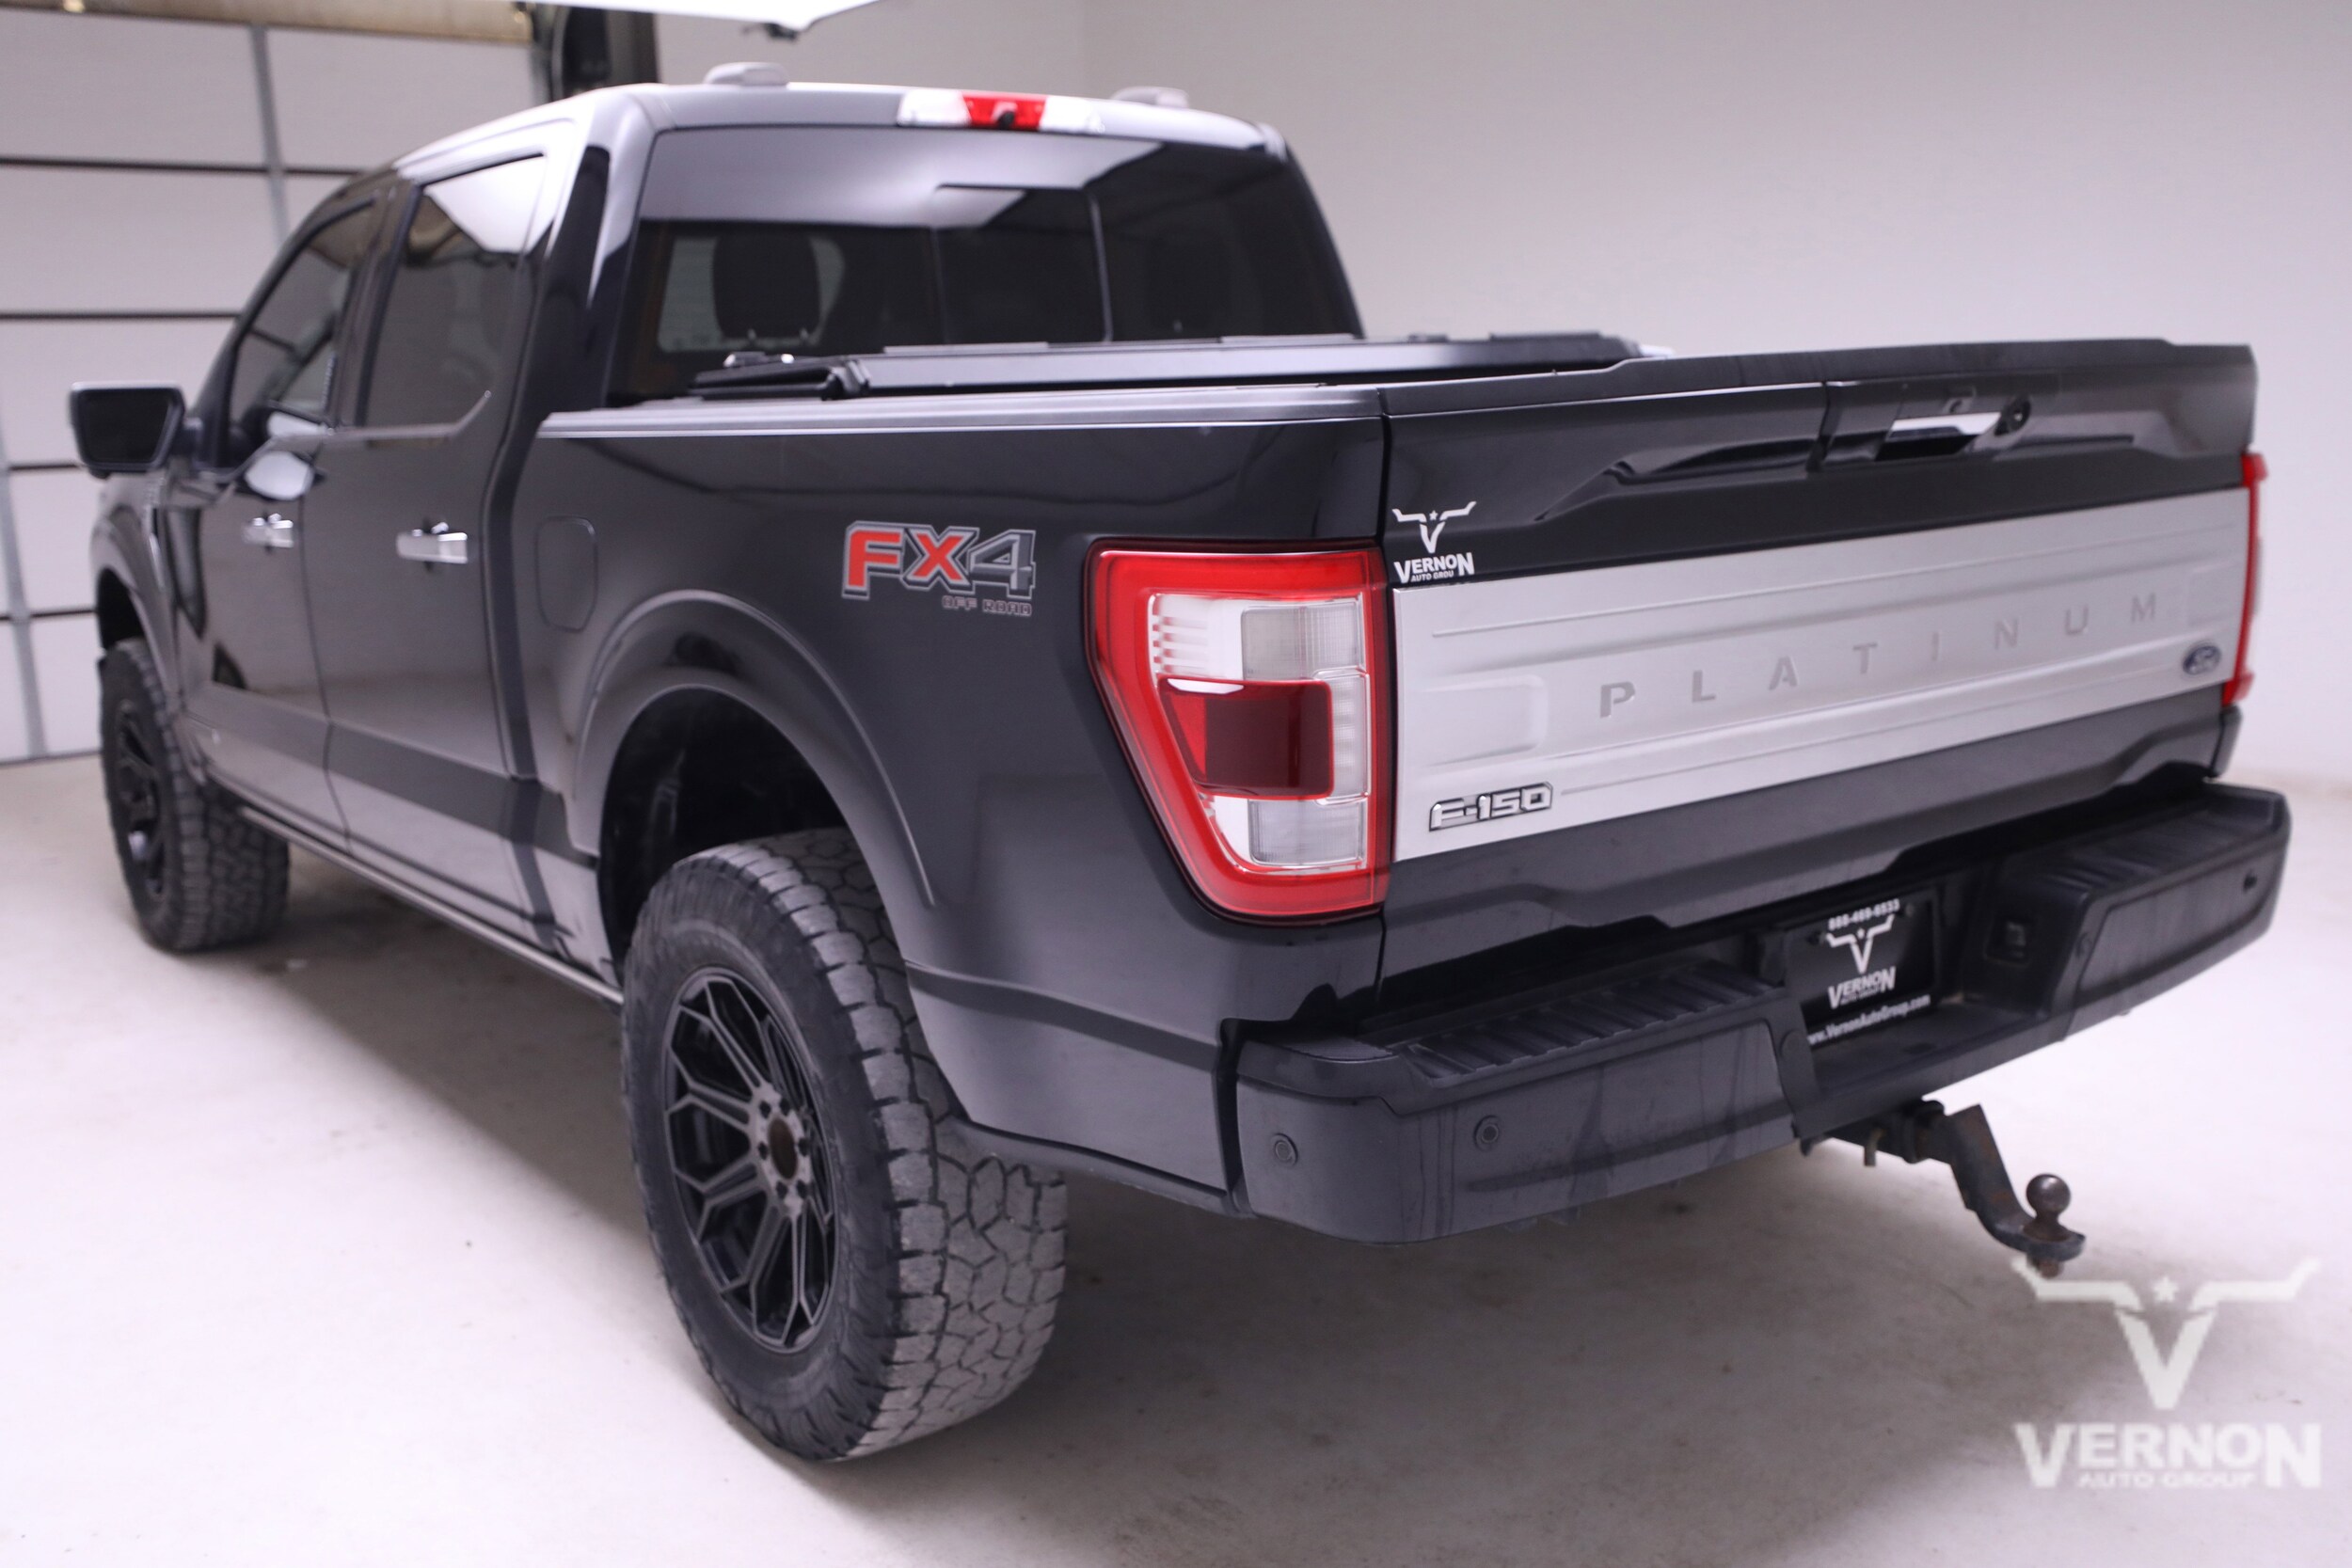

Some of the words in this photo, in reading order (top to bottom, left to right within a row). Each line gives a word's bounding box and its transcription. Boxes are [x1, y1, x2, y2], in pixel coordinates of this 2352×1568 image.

[841, 520, 1036, 600] FX4
[1393, 552, 1474, 583] VERNON
[1410, 573, 1432, 582] AUTO
[942, 594, 977, 611] OFF
[982, 598, 1032, 617] ROAD
[1598, 594, 2156, 719] PLATINUM
[1429, 781, 1553, 832] F-150
[1828, 966, 1896, 1009] VERNON
